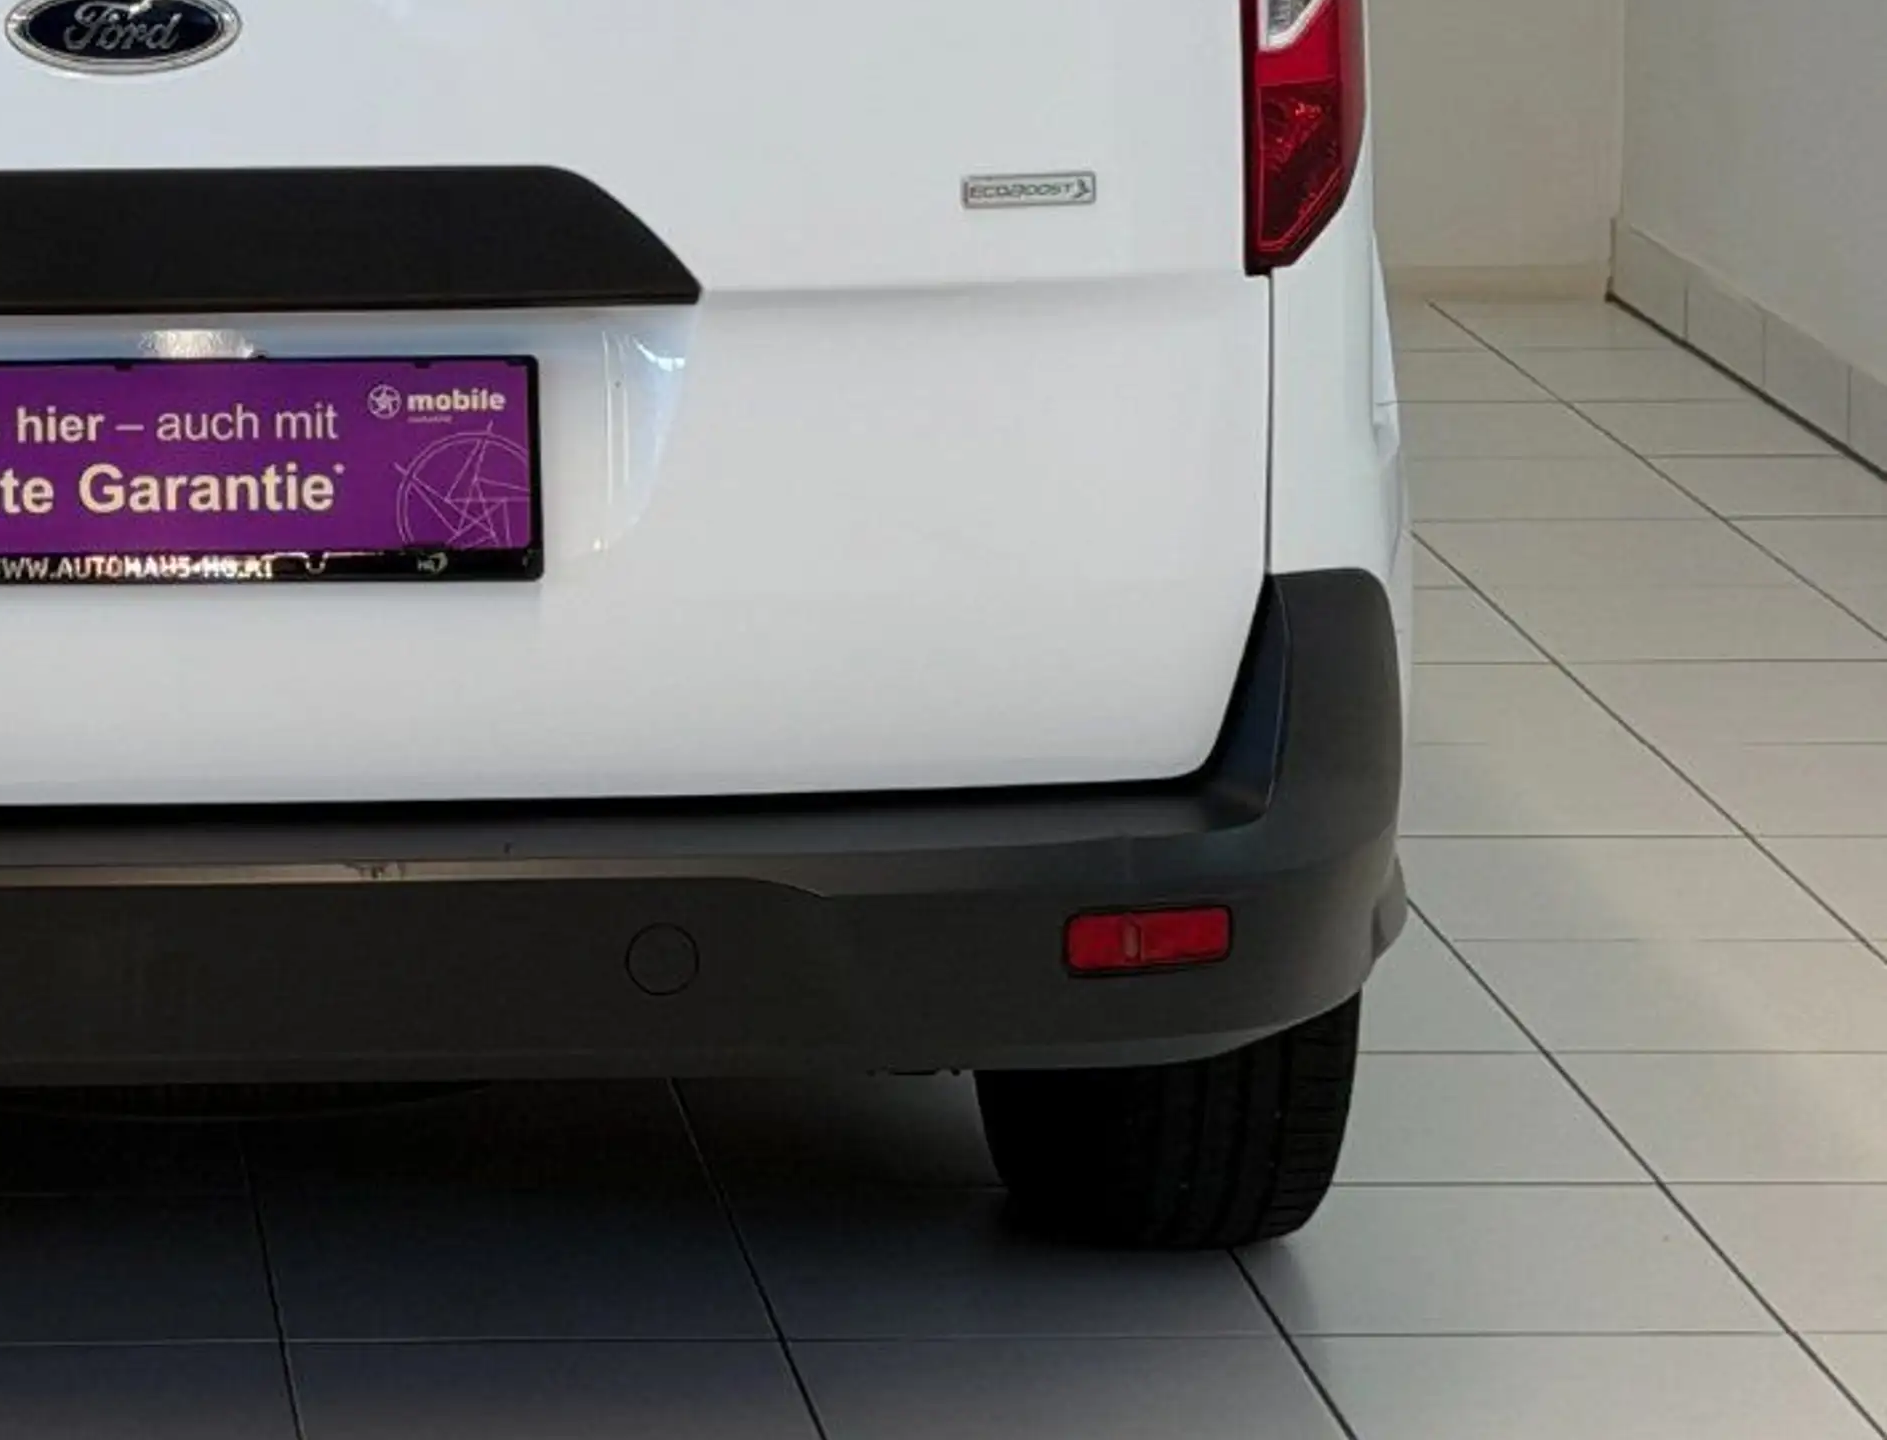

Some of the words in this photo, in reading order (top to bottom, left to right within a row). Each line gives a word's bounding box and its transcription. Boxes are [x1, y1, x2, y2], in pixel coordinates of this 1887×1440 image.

[64, 0, 182, 50] Ford
[969, 183, 1074, 199] ECOBOOST
[407, 388, 507, 411] mobile
[16, 405, 105, 443] hier
[156, 404, 260, 441] auch
[275, 402, 339, 440] mit
